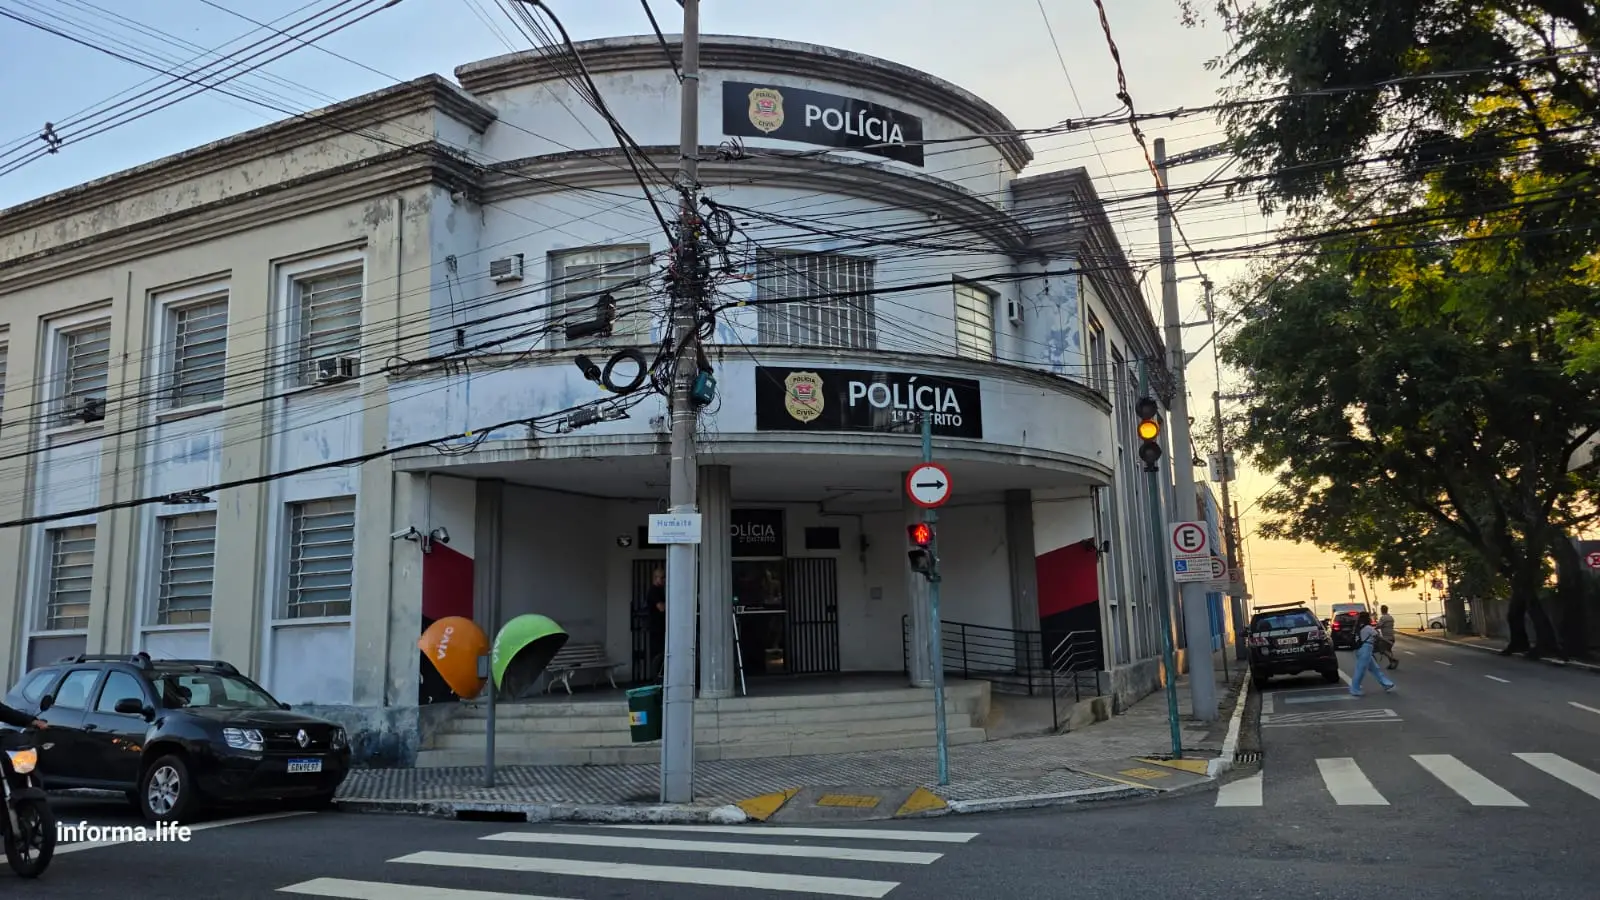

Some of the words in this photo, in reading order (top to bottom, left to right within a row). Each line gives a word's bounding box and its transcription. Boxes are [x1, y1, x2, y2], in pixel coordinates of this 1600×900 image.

[804, 103, 906, 147] POLÍCIA
[848, 376, 961, 413] POLÍCIA
[730, 521, 775, 537] OLÍCIA
[1183, 530, 1196, 547] E
[1211, 562, 1220, 574] E
[437, 626, 454, 661] vivo
